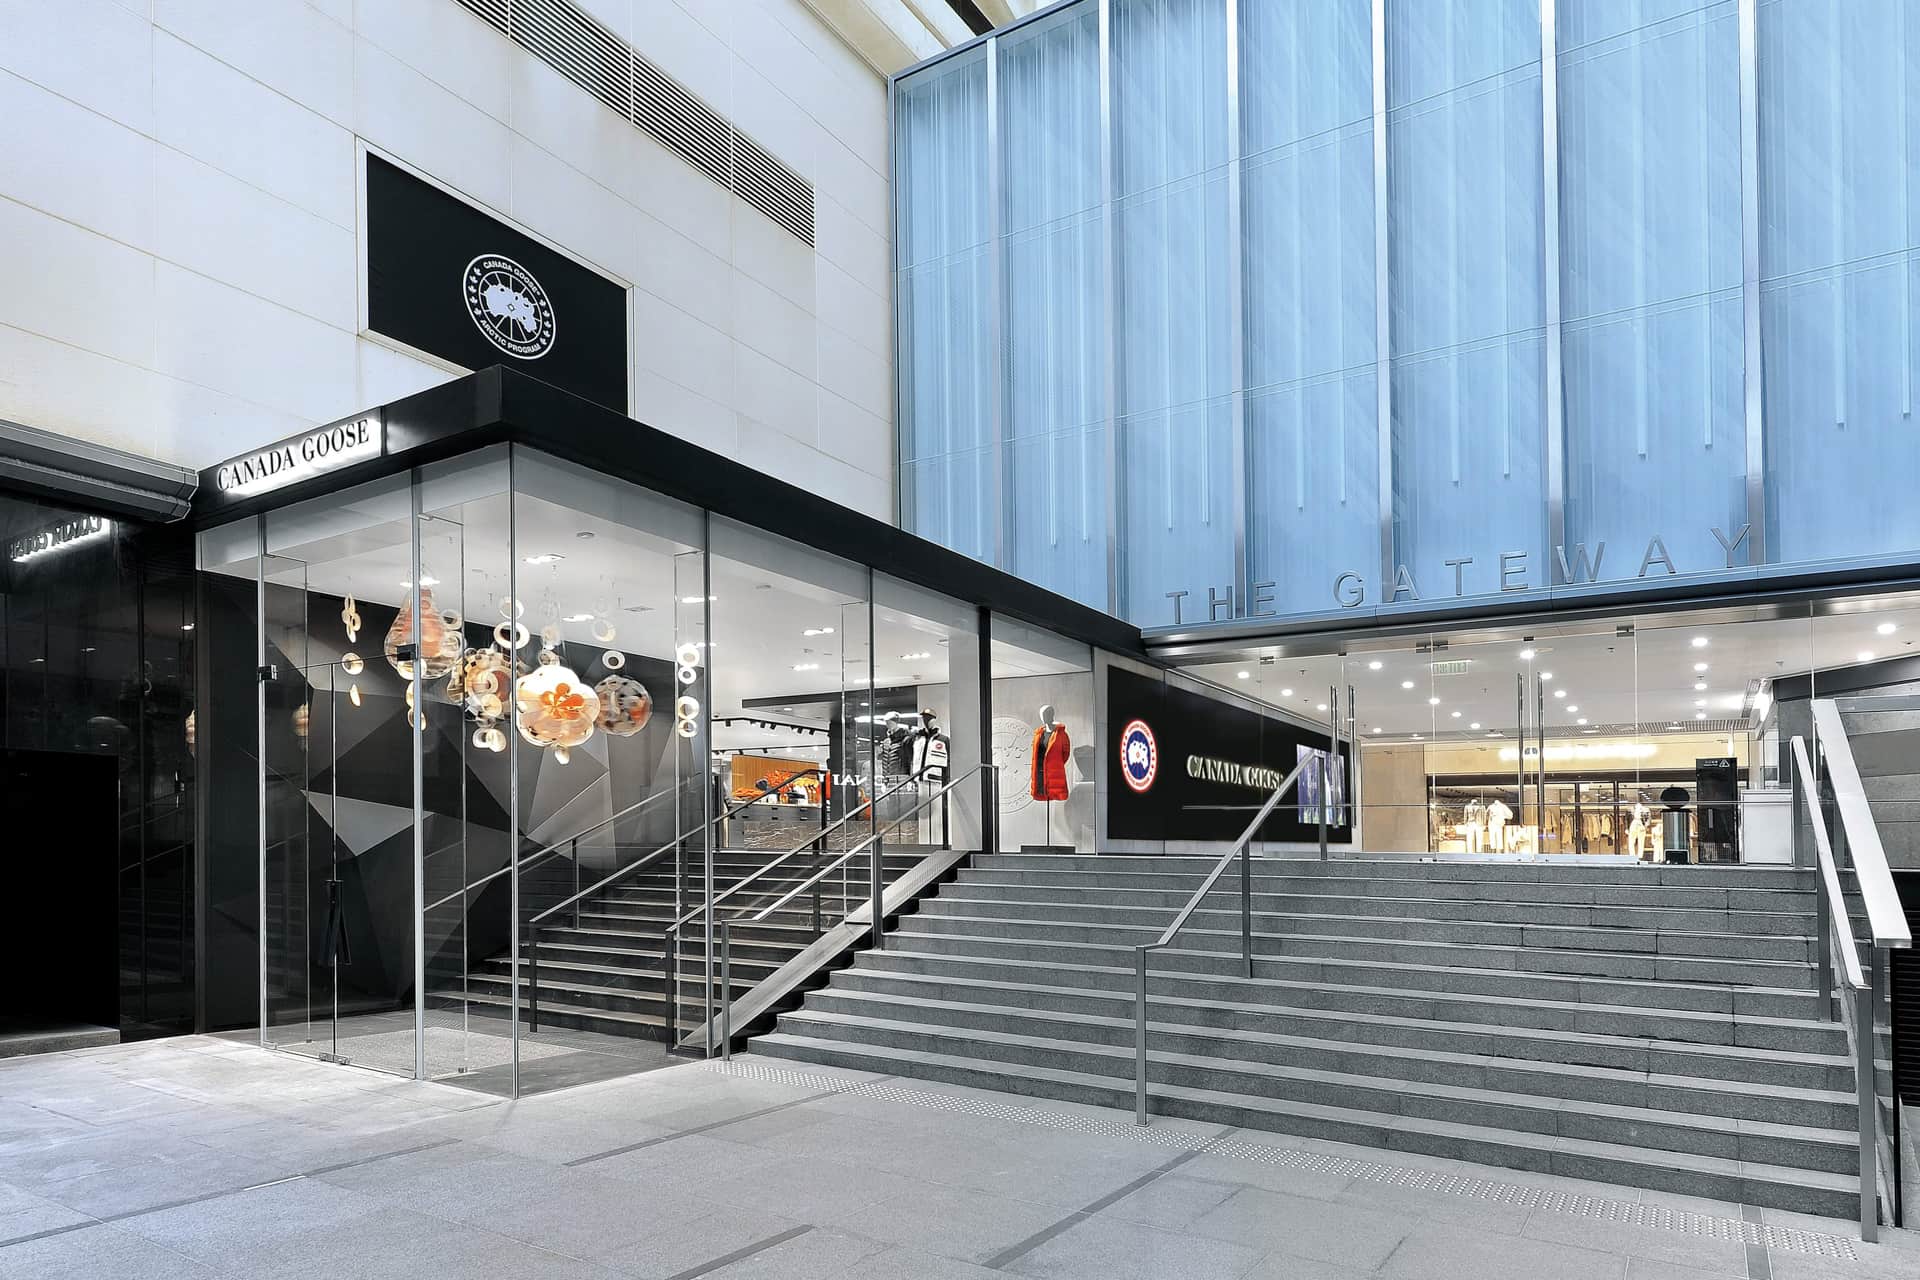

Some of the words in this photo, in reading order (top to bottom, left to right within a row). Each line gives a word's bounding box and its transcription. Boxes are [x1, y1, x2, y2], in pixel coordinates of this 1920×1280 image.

[483, 260, 513, 272] CANADA
[514, 268, 537, 293] GOOSE
[480, 319, 507, 346] ARCTIC
[507, 343, 541, 354] PROGRAM
[217, 446, 296, 492] CANADA
[302, 419, 370, 462] GOOSE
[1166, 581, 1277, 625] THE
[1333, 523, 1751, 609] GATEWAY
[1187, 754, 1242, 785] CANADA
